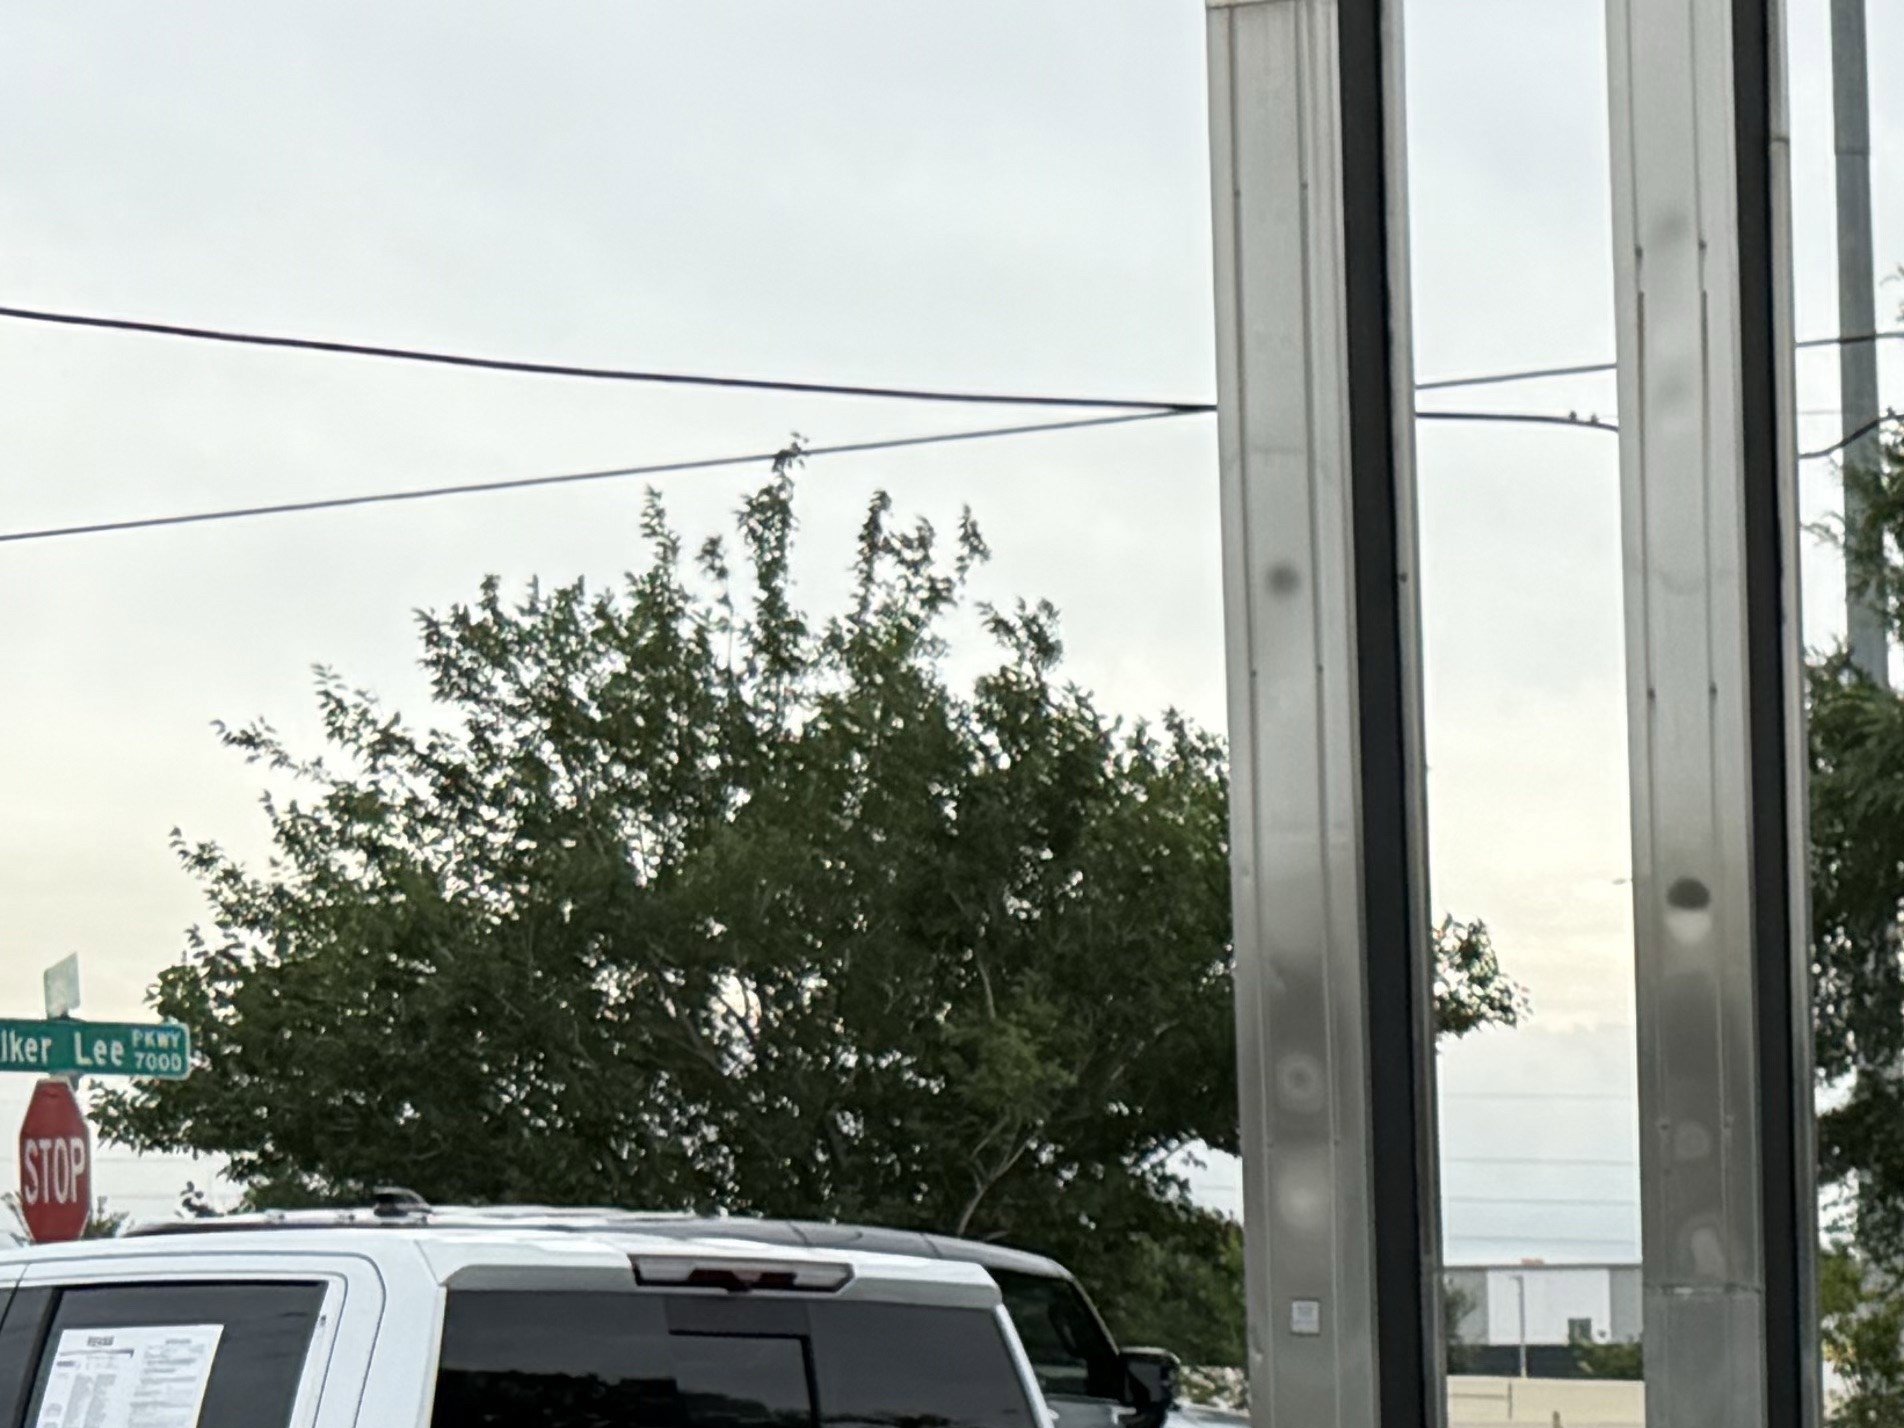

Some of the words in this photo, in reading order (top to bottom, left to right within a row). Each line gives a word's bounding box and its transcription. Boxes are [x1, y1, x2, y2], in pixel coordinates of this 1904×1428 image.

[0, 1029, 52, 1063] lker
[74, 1031, 124, 1066] Lee
[131, 1029, 181, 1048] PKWY
[134, 1052, 182, 1072] 7000
[24, 1137, 86, 1204] STOP
